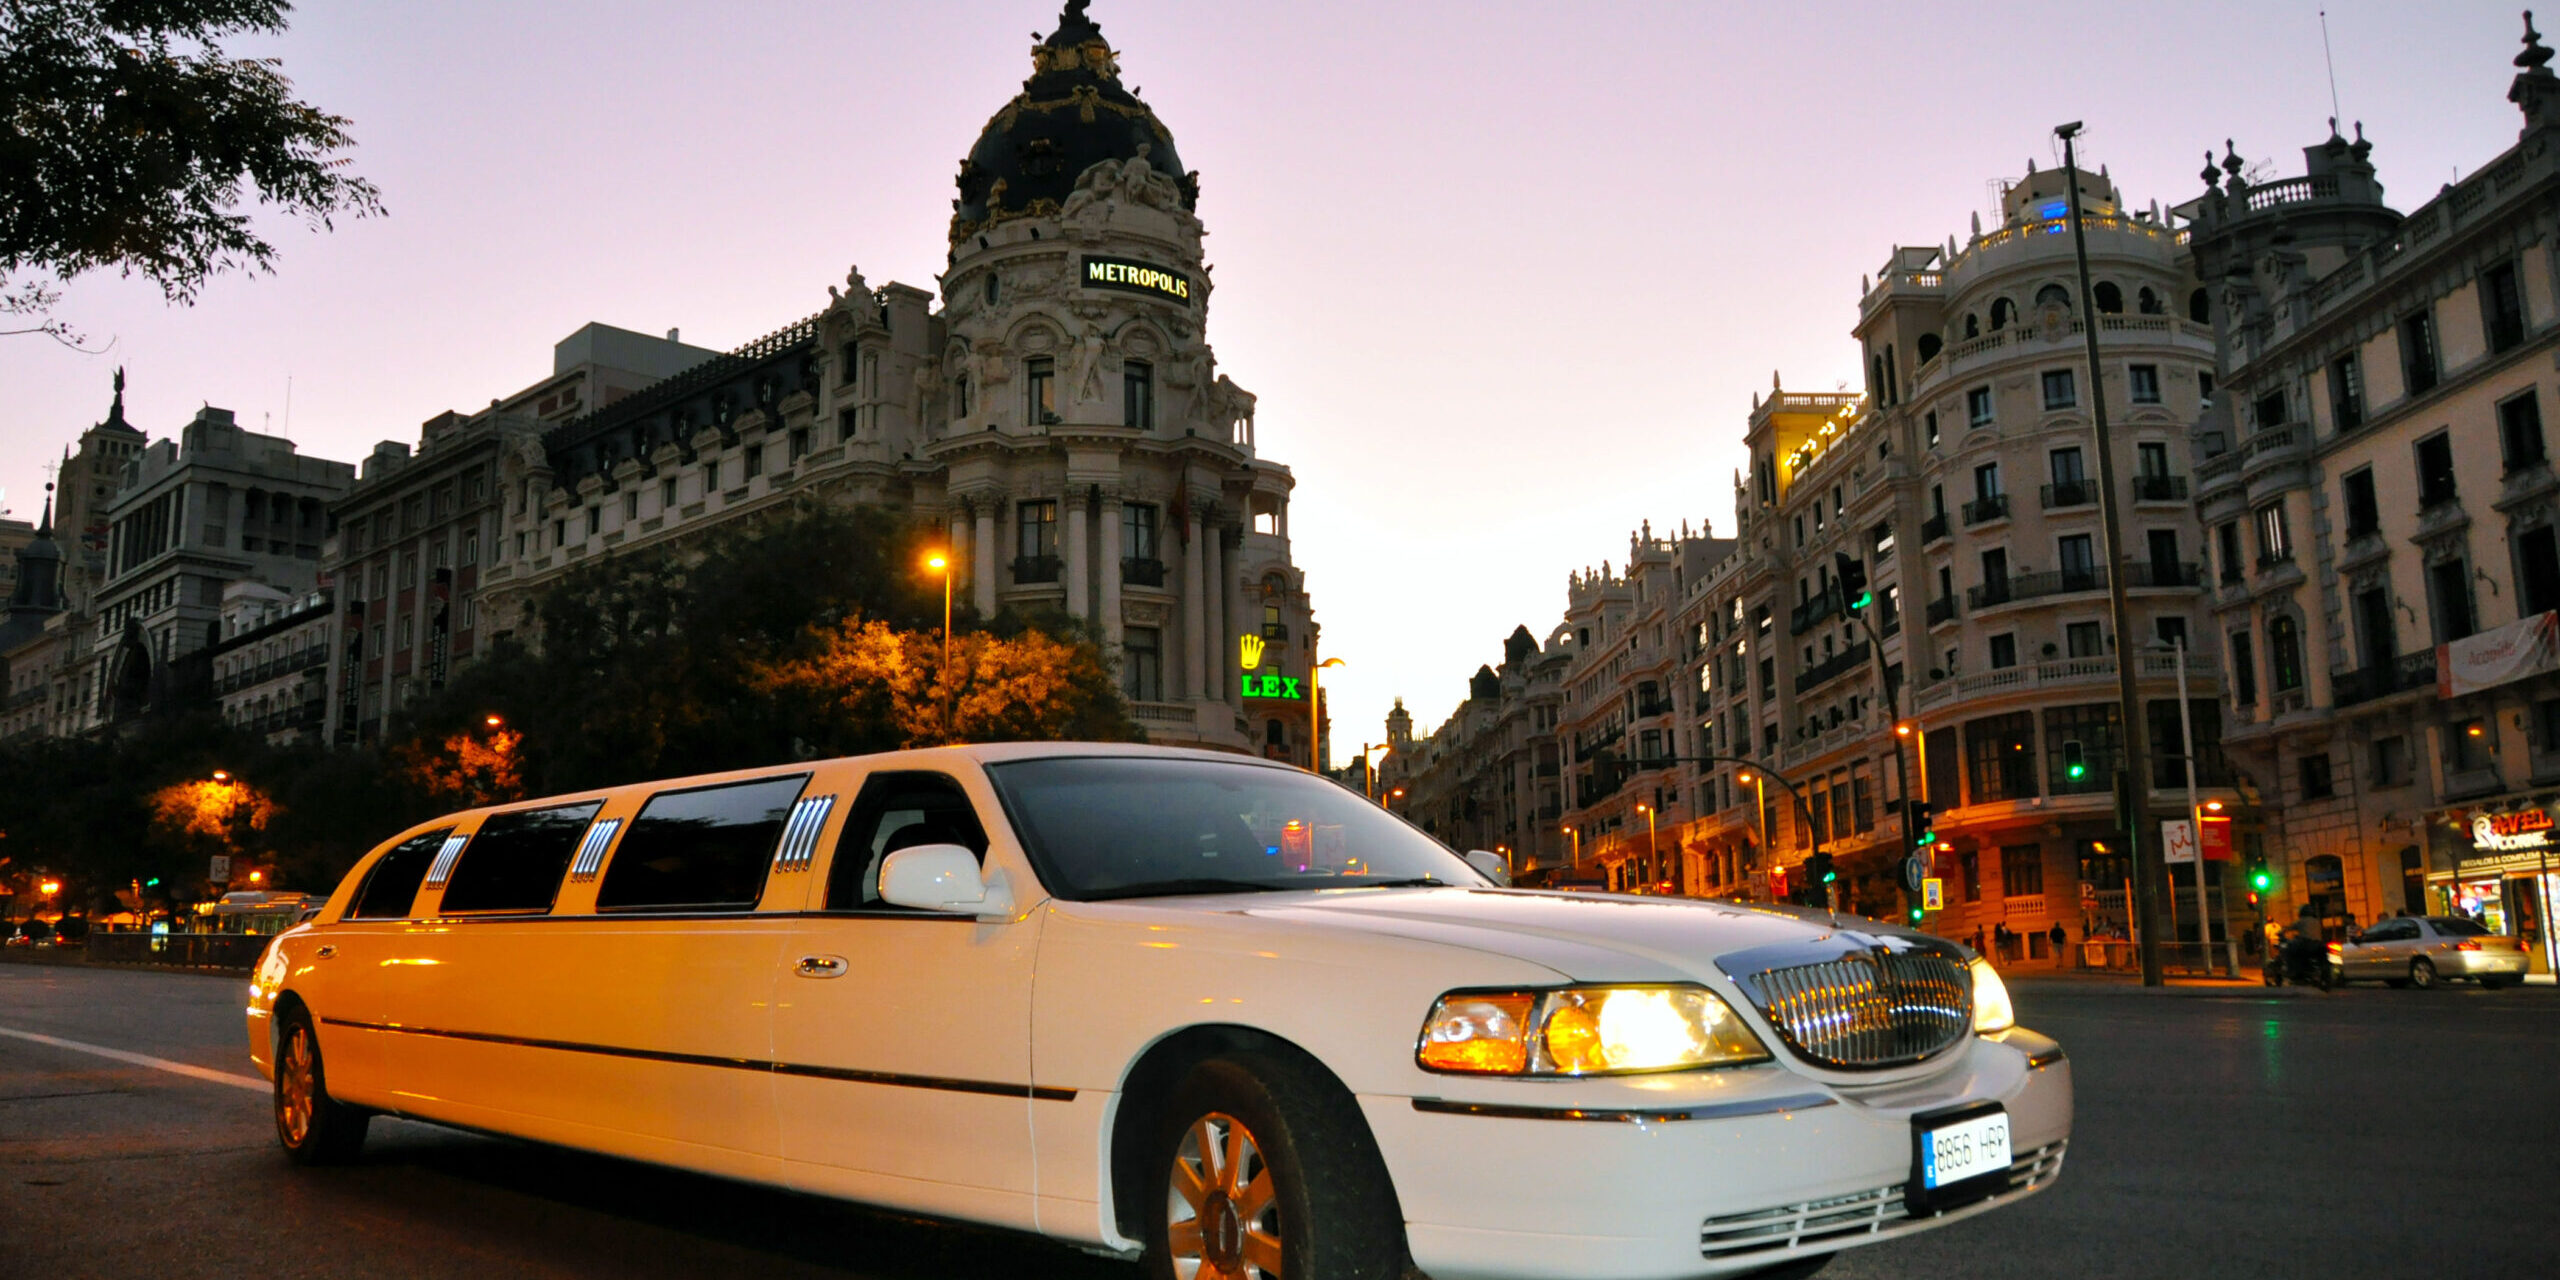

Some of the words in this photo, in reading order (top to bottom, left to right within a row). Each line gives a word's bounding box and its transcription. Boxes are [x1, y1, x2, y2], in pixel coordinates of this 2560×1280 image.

[1089, 262, 1188, 298] METROPOLIS
[1241, 674, 1301, 699] LEX
[1936, 1132, 1972, 1172] 8856
